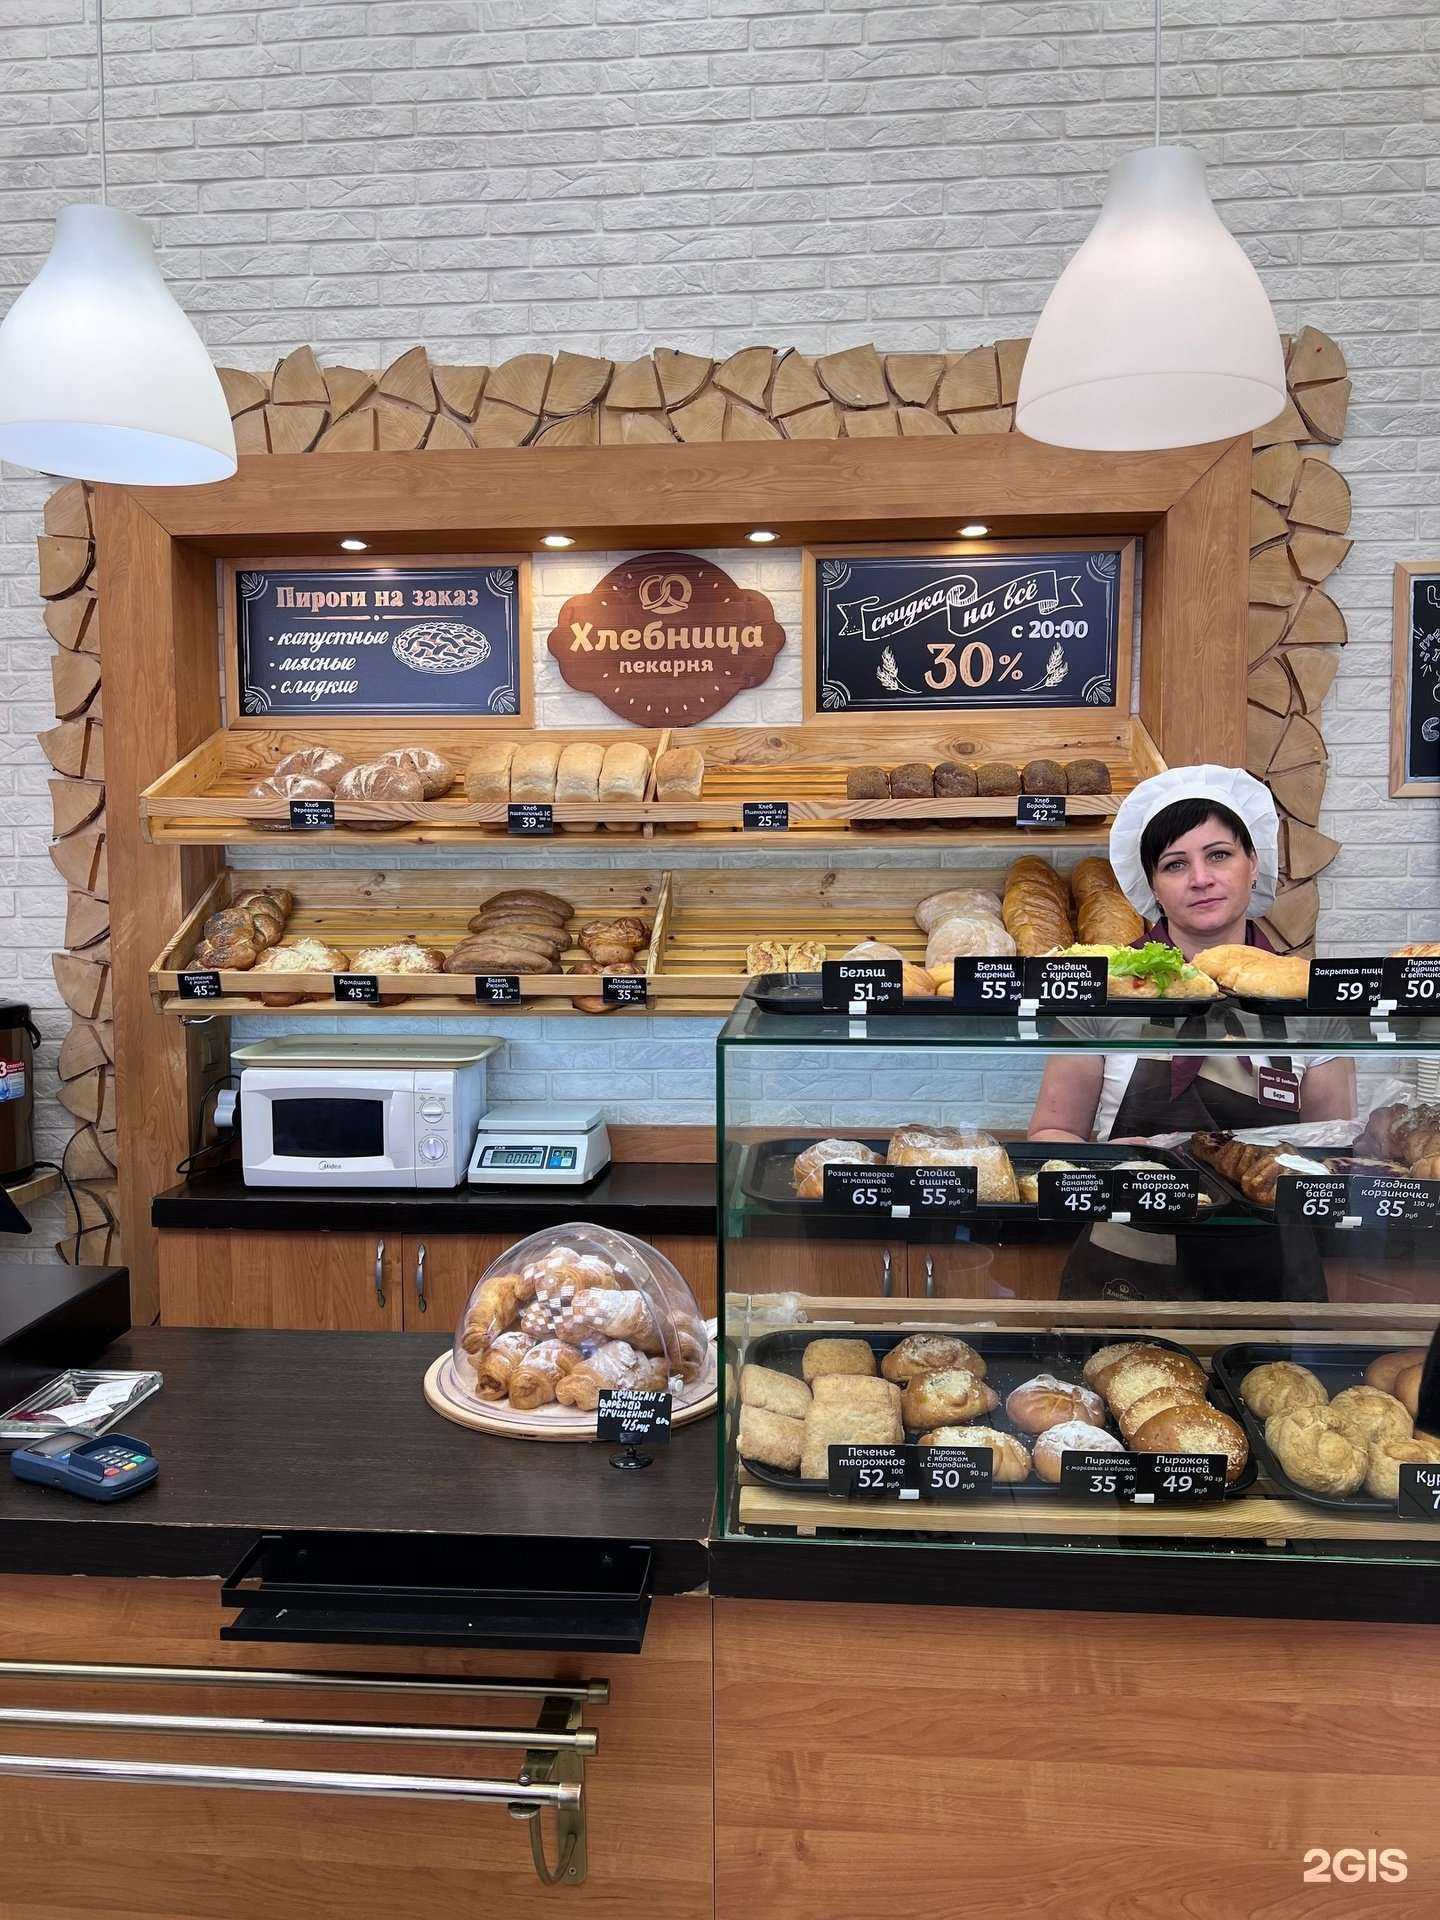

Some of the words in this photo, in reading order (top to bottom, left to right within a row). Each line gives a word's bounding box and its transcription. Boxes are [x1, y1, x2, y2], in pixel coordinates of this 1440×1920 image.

[276, 586, 367, 612] Пироги
[374, 588, 405, 607] на
[412, 588, 479, 607] заказ
[871, 590, 946, 632] скидка
[963, 603, 996, 628] на
[1003, 579, 1038, 609] всё
[1011, 626, 1023, 639] с
[1027, 620, 1089, 639] 20:00
[277, 629, 389, 653] капустные
[569, 620, 764, 655] Хлебница
[279, 655, 357, 672] мясные
[619, 658, 714, 677] пекарня
[924, 641, 1023, 690] 30%
[280, 678, 359, 702] сладкие
[305, 814, 319, 825] 35
[758, 815, 772, 827] 25
[1032, 810, 1048, 821] 42
[522, 817, 537, 828] 39
[977, 962, 1013, 971] Беляш
[1046, 962, 1088, 972] Сэндвич
[1407, 959, 1440, 967] Пирожо
[840, 966, 886, 978] Беляш
[974, 971, 1016, 979] жареный
[1049, 970, 1092, 980] курицей
[1315, 967, 1359, 976] Закрытая
[1361, 967, 1383, 975] пицц
[1411, 966, 1440, 974] курице
[339, 978, 371, 986] Ромашка
[193, 985, 208, 996] 45
[348, 988, 363, 998] 45
[492, 988, 505, 999] 21
[853, 982, 875, 1000] 51
[981, 981, 1006, 999] 55
[1040, 981, 1079, 999] 105
[1336, 982, 1364, 1001] 59
[1405, 979, 1434, 998] 50
[617, 989, 631, 1000] 35
[1368, 993, 1381, 1001] руб
[0, 1061, 7, 1077] 3
[916, 1168, 956, 1177] Слойка
[1136, 1171, 1176, 1181] Сочень
[919, 1178, 962, 1186] вишней
[1132, 1182, 1189, 1191] творогом
[1296, 1181, 1345, 1190] Ромовая
[1373, 1179, 1421, 1190] Ягодная
[1061, 1184, 1098, 1192] начинкой
[1306, 1189, 1333, 1198] баба
[1361, 1188, 1429, 1199] корзиночка
[852, 1188, 878, 1205] 65
[921, 1188, 947, 1205] 55
[1064, 1193, 1092, 1211] 45
[1138, 1192, 1167, 1210] 48
[1303, 1199, 1330, 1216] 65
[1376, 1200, 1405, 1217] 85
[611, 1390, 657, 1402] КРУАССАН
[848, 1448, 896, 1457] Печенье
[930, 1449, 966, 1457] Пирожок
[839, 1458, 906, 1467] творожное
[1085, 1456, 1131, 1465] Пирожок
[1156, 1455, 1210, 1466] Пирожок
[1164, 1464, 1210, 1474] вишней
[858, 1469, 885, 1488] 52
[930, 1470, 960, 1488] 50
[1089, 1475, 1117, 1493] 35
[1162, 1475, 1193, 1493] 49
[1416, 1470, 1440, 1487] Кур
[887, 1481, 900, 1489] руб
[1432, 1489, 1440, 1510] 7
